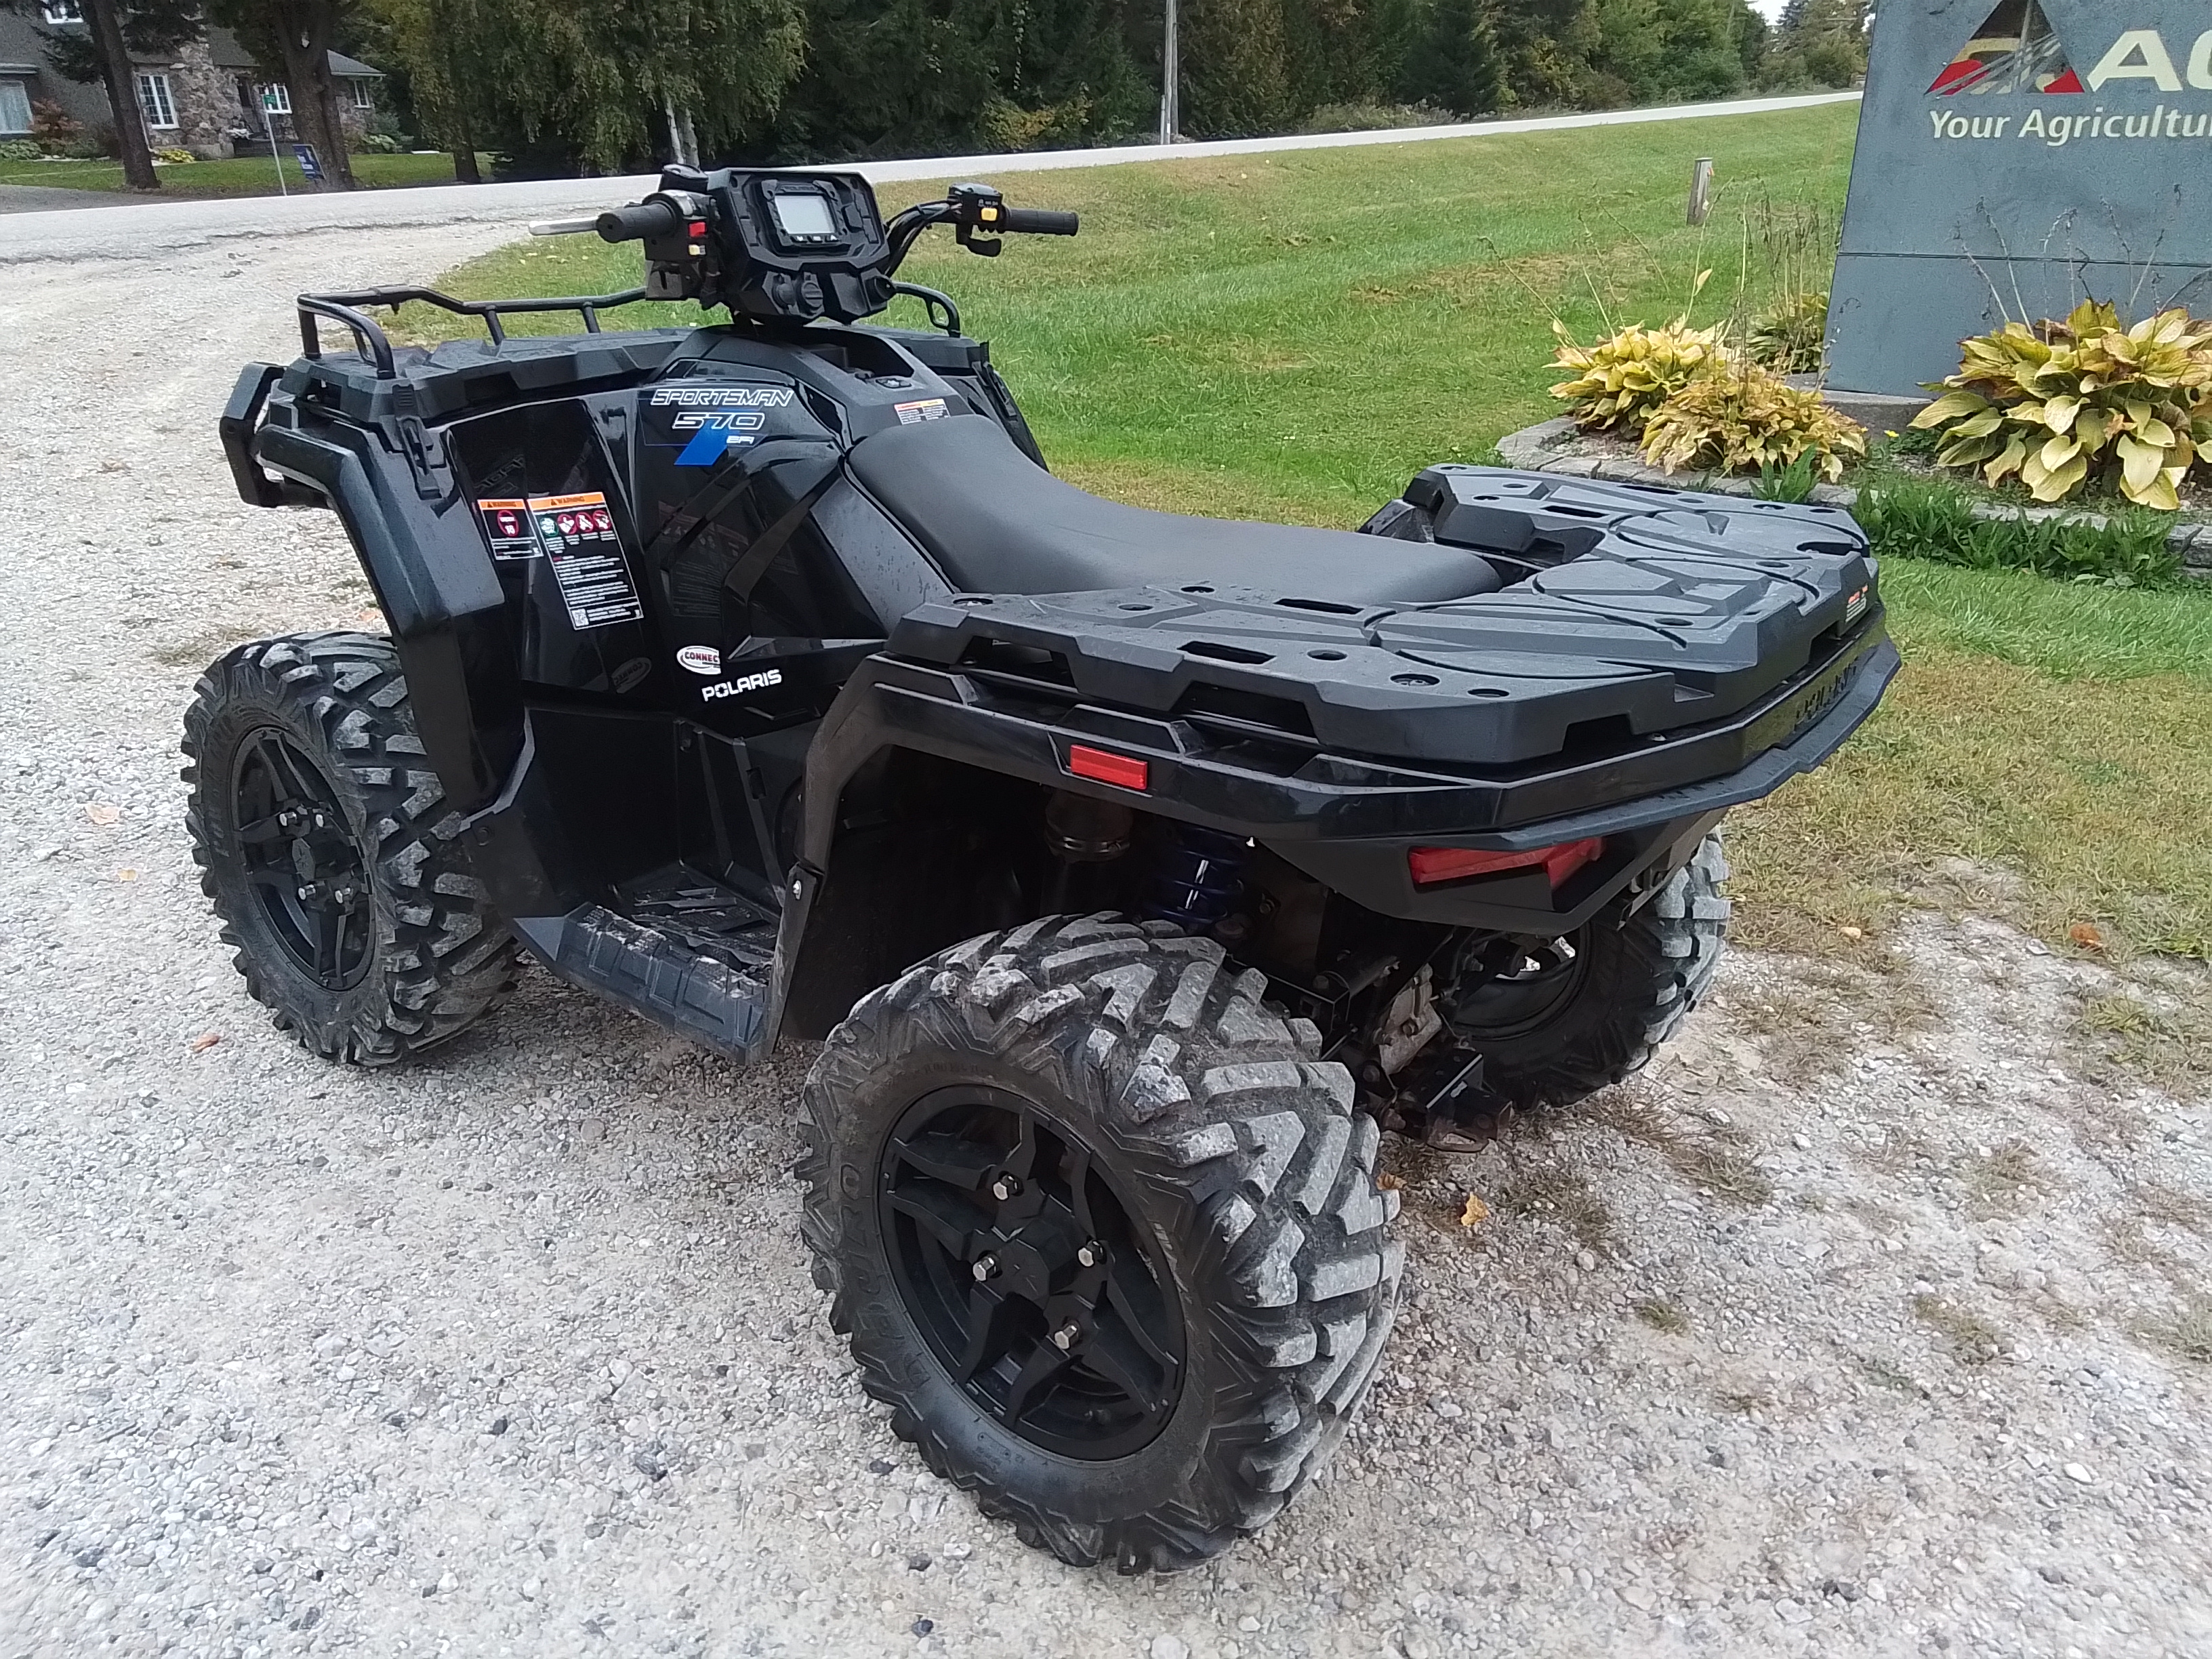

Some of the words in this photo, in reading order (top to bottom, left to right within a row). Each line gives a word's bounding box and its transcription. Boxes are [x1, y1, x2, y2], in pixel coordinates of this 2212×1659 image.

[1929, 110, 2011, 138] Your
[2018, 104, 2212, 146] Agricultu
[650, 388, 794, 407] SPORTSMAN
[672, 412, 765, 430] 570
[701, 669, 782, 702] POLARIS
